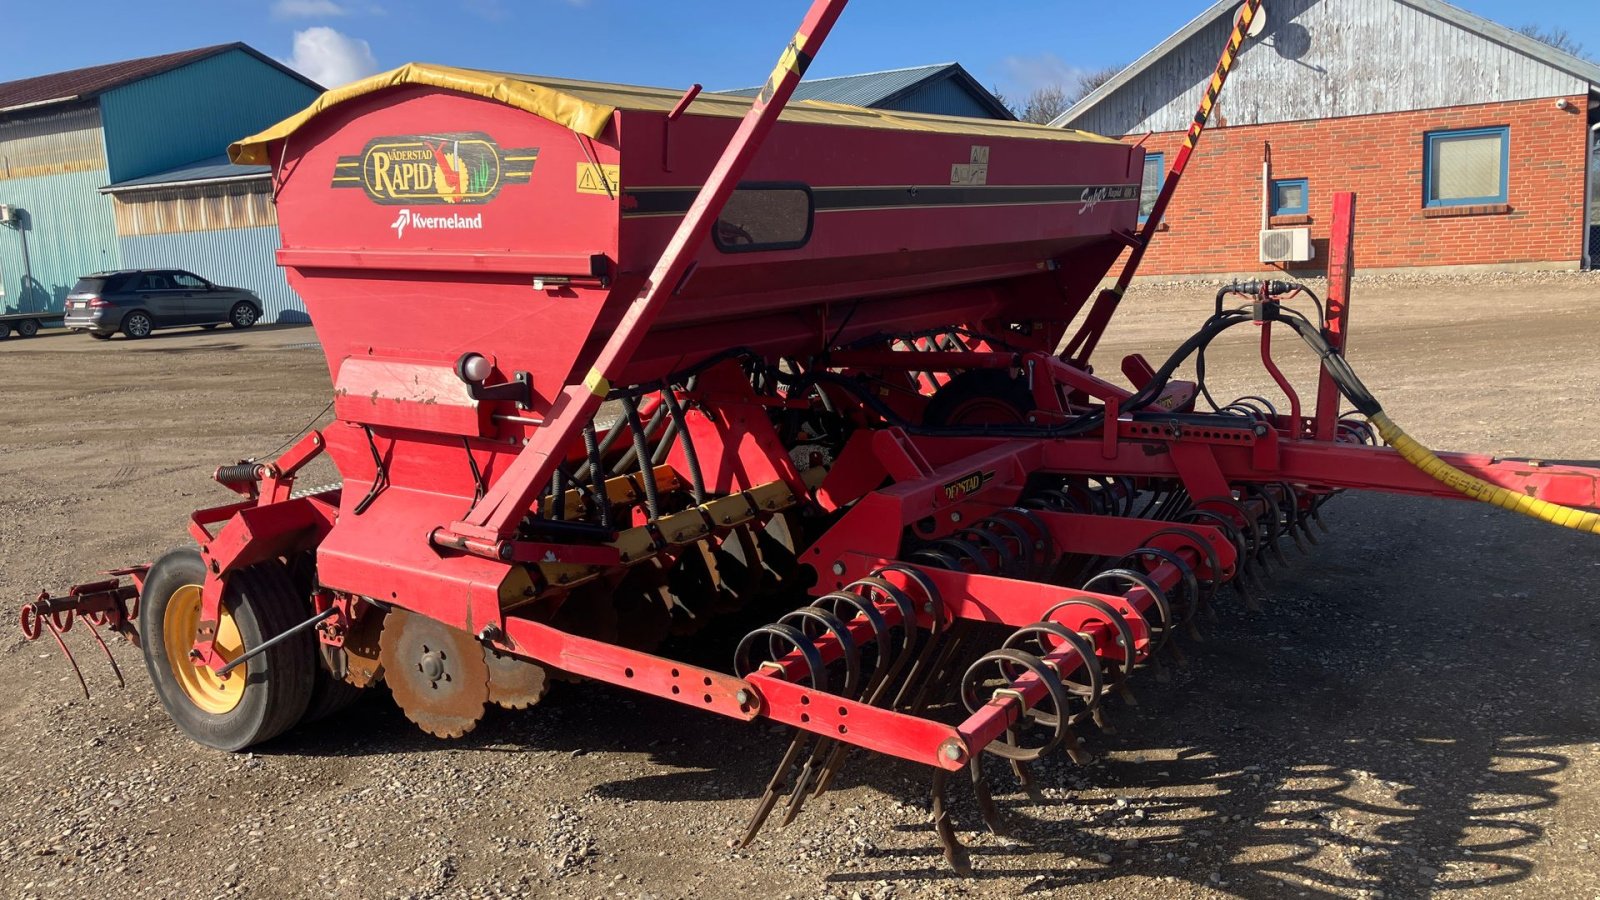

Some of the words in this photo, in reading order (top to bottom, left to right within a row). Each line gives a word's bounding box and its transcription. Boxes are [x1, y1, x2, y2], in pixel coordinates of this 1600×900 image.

[387, 149, 433, 161] VÄDERSTAD
[372, 152, 433, 195] RAPID
[412, 213, 482, 229] Kverneland
